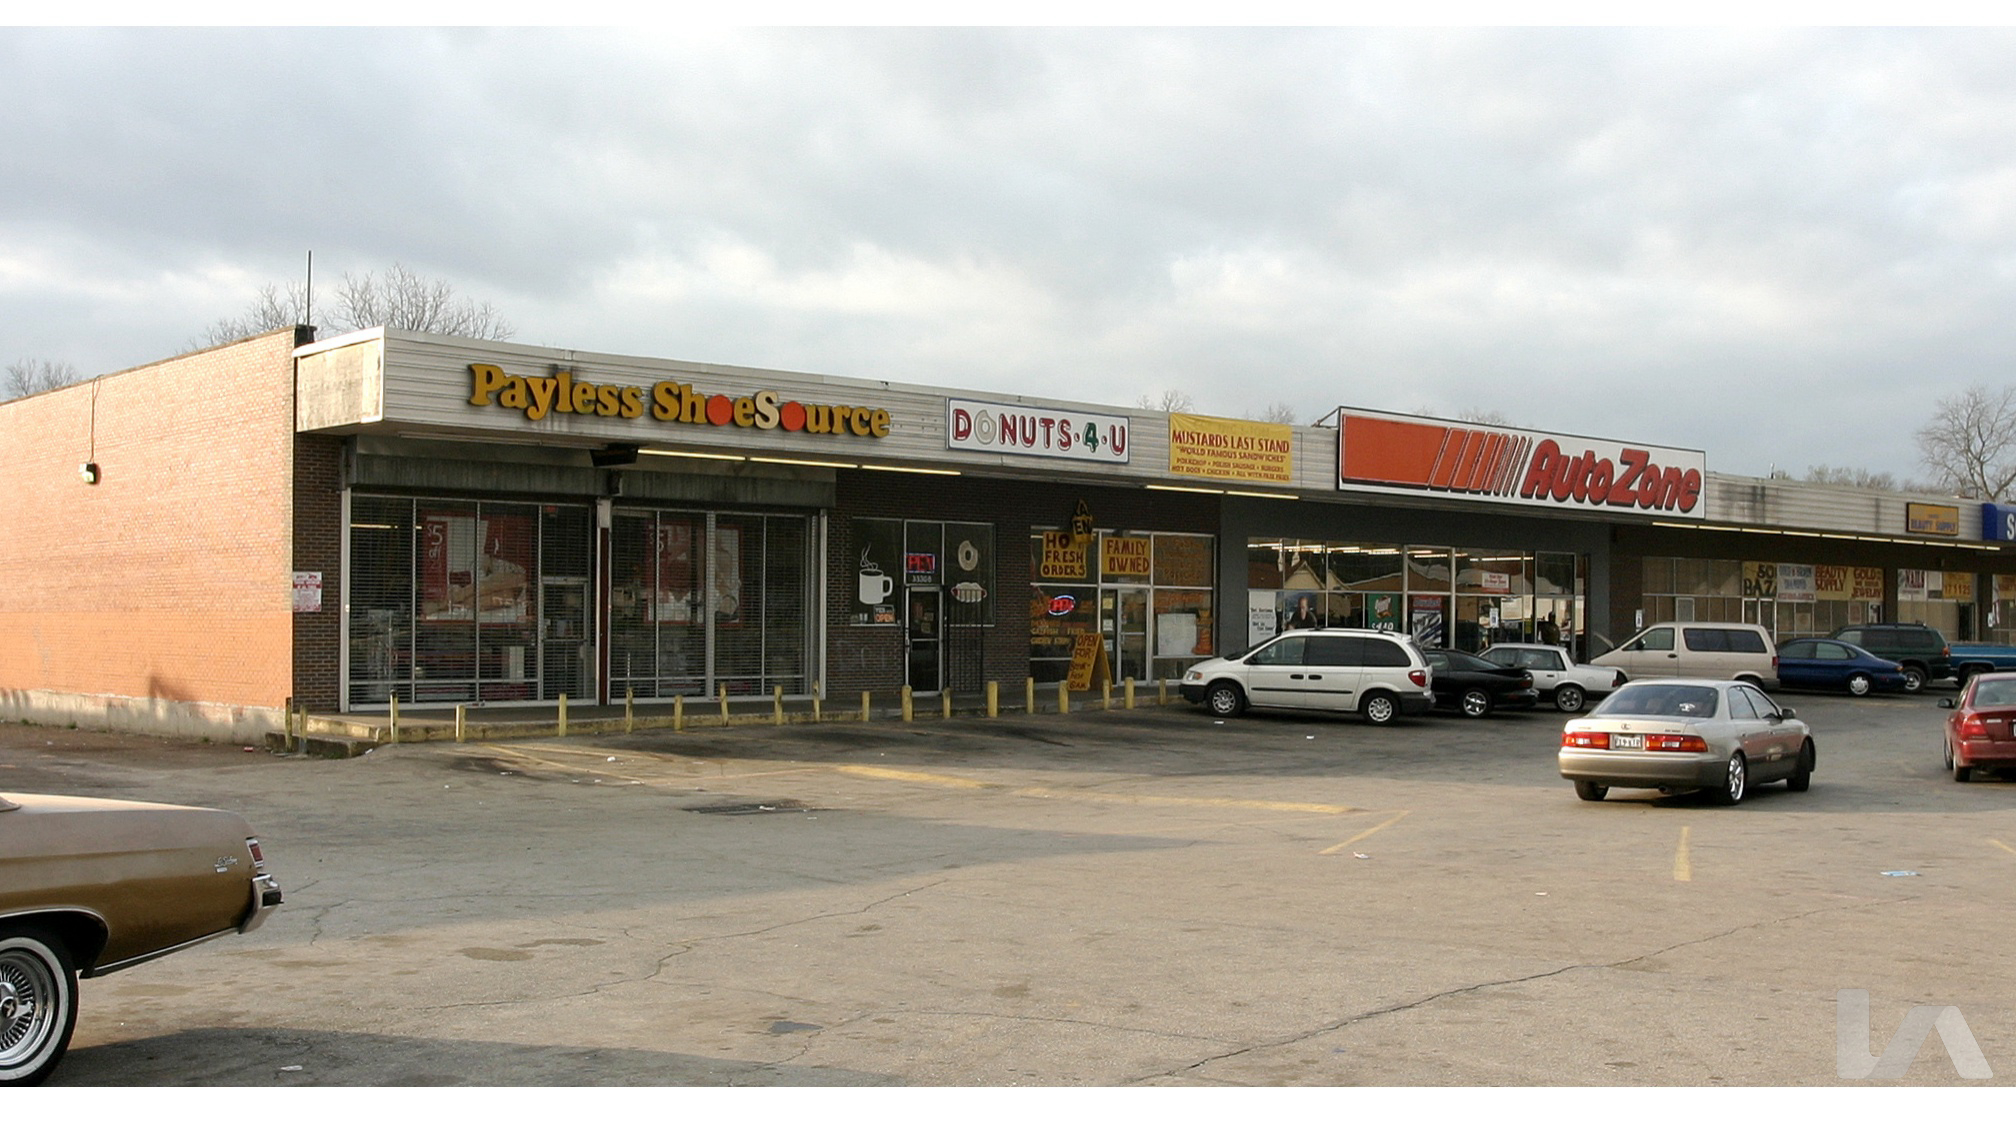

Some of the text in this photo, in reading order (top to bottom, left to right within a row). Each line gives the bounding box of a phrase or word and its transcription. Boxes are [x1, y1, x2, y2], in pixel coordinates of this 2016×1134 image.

[468, 363, 891, 438] Payless ShoeSource
[1172, 430, 1290, 454] MUSTARDS LAST STAND
[1520, 438, 1702, 514] AutoZone
[1106, 539, 1148, 555] FAMILY
[1045, 550, 1083, 563] FRESH
[1042, 564, 1086, 576] ORDERS
[1109, 557, 1150, 573] OWNED
[1815, 565, 1848, 579] BEAUTY
[1853, 567, 1877, 580] GOLD
[1815, 579, 1845, 592] SUPPLY
[1077, 634, 1097, 646] OPEN
